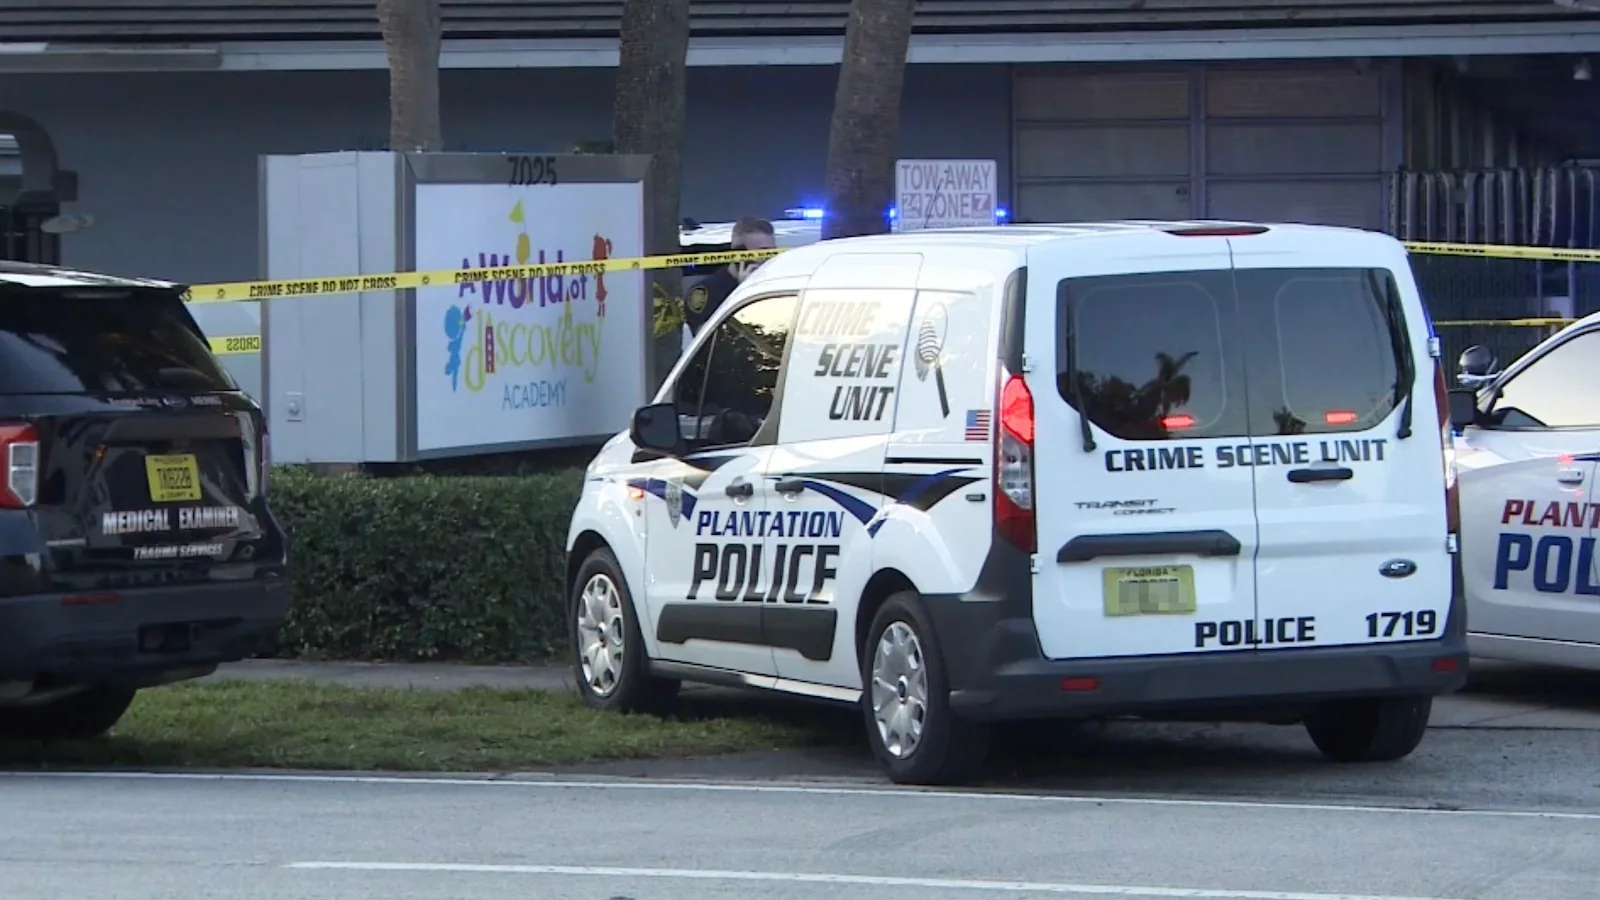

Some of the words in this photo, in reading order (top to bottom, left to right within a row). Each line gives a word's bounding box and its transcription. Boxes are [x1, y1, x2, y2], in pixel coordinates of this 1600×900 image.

[508, 156, 557, 187] 7025
[924, 194, 970, 219] ZONE
[249, 284, 283, 298] CRIME
[285, 281, 319, 296] SCENE
[321, 280, 337, 292] DO
[339, 278, 360, 291] NOT
[362, 276, 397, 290] CROSS
[454, 271, 489, 284] CRIME
[492, 267, 526, 280] SCENE
[529, 266, 544, 278] DO
[548, 264, 568, 276] NOT
[571, 262, 606, 275] CROSS
[799, 302, 880, 336] CRIME
[464, 308, 603, 392] discovery
[814, 344, 898, 378] SCENE
[503, 379, 568, 411] ACADEMY
[829, 386, 894, 421] UNIT
[1105, 447, 1204, 472] CRIME
[1216, 442, 1309, 468] SCENE
[1320, 438, 1388, 462] UNIT
[103, 508, 171, 535] MEDICAL
[179, 505, 239, 530] EXAMINER
[696, 511, 845, 538] PLANTATION
[687, 543, 840, 604] POLICE
[1195, 616, 1316, 648] POLICE
[1365, 609, 1437, 638] 1719
